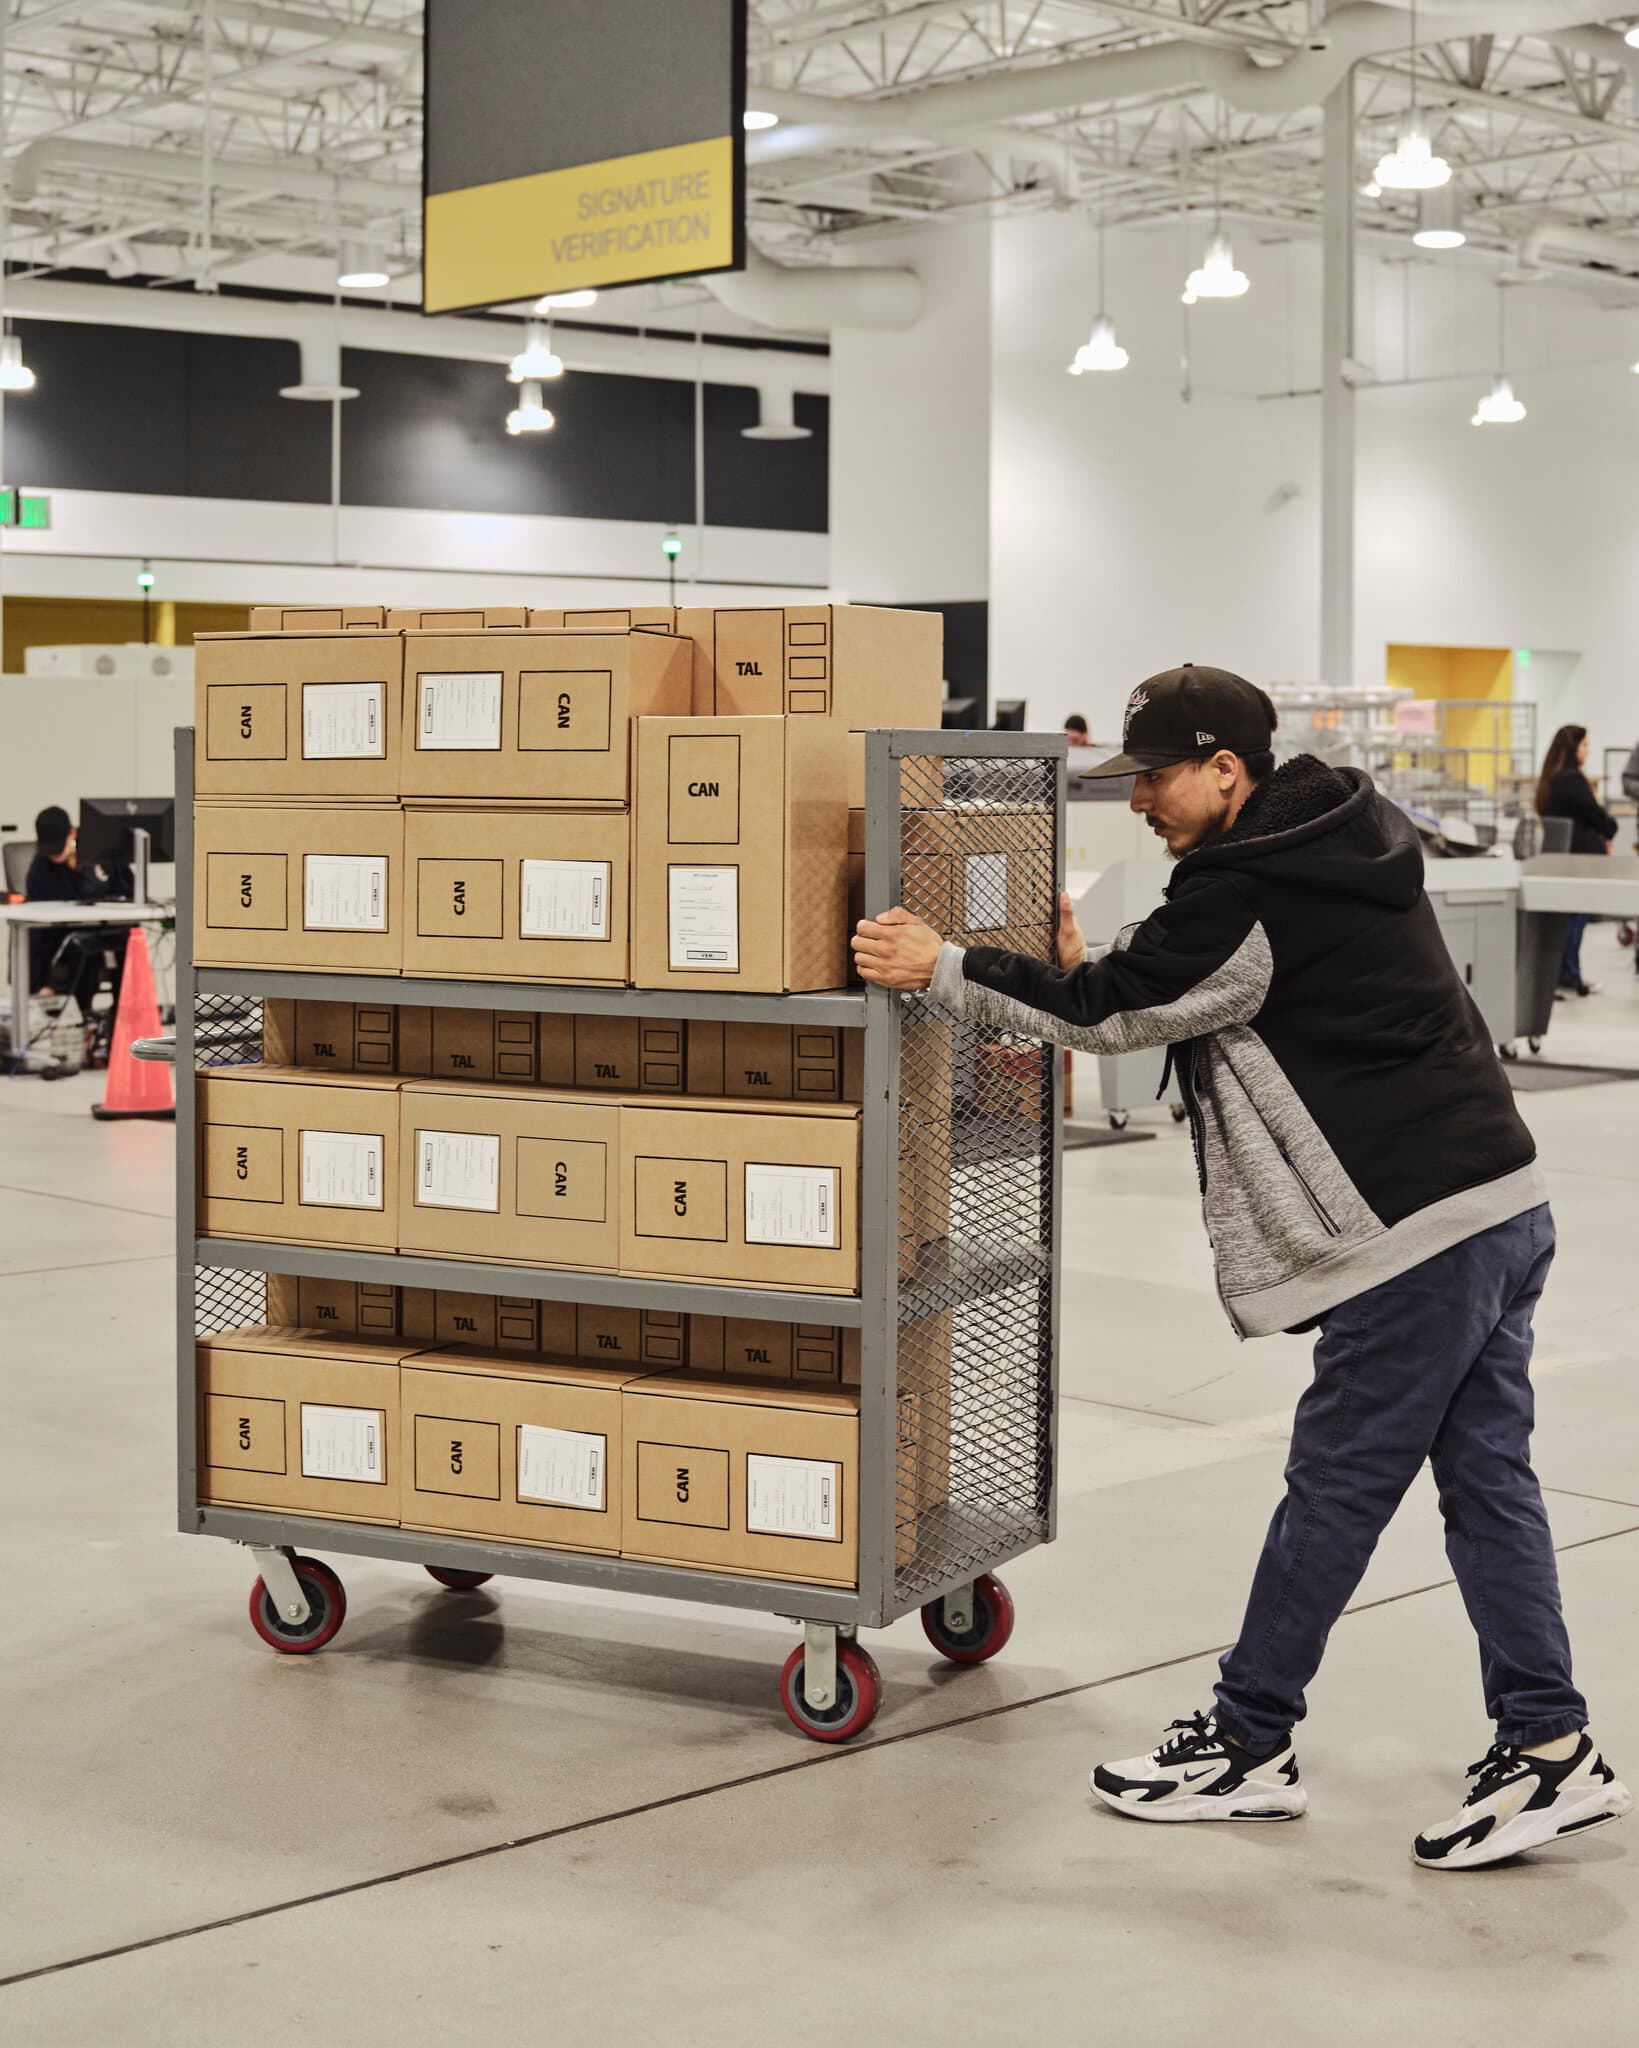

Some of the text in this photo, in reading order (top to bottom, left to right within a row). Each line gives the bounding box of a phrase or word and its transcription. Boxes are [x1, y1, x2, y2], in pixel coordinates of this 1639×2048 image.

[576, 169, 710, 221] SIGNATURE
[551, 210, 711, 264] VERIFICATION
[735, 661, 763, 676] TAL
[240, 705, 252, 740] CAN
[557, 693, 571, 729] CAN
[687, 782, 719, 797] CAN
[240, 874, 252, 908] CAN
[453, 881, 466, 916] CAN
[312, 1042, 336, 1057] TAL
[450, 1054, 476, 1069] TAL
[594, 1063, 620, 1079] TAL
[744, 1070, 773, 1086] TAL
[236, 1146, 248, 1180] CAN
[554, 1161, 567, 1197] CAN
[674, 1181, 687, 1217] CAN
[315, 1305, 339, 1320] TAL
[453, 1316, 478, 1332] TAL
[596, 1334, 621, 1350] TAL
[744, 1348, 772, 1364] TAL
[239, 1417, 251, 1451] CAN
[450, 1440, 463, 1475] CAN
[676, 1467, 689, 1504] CAN
